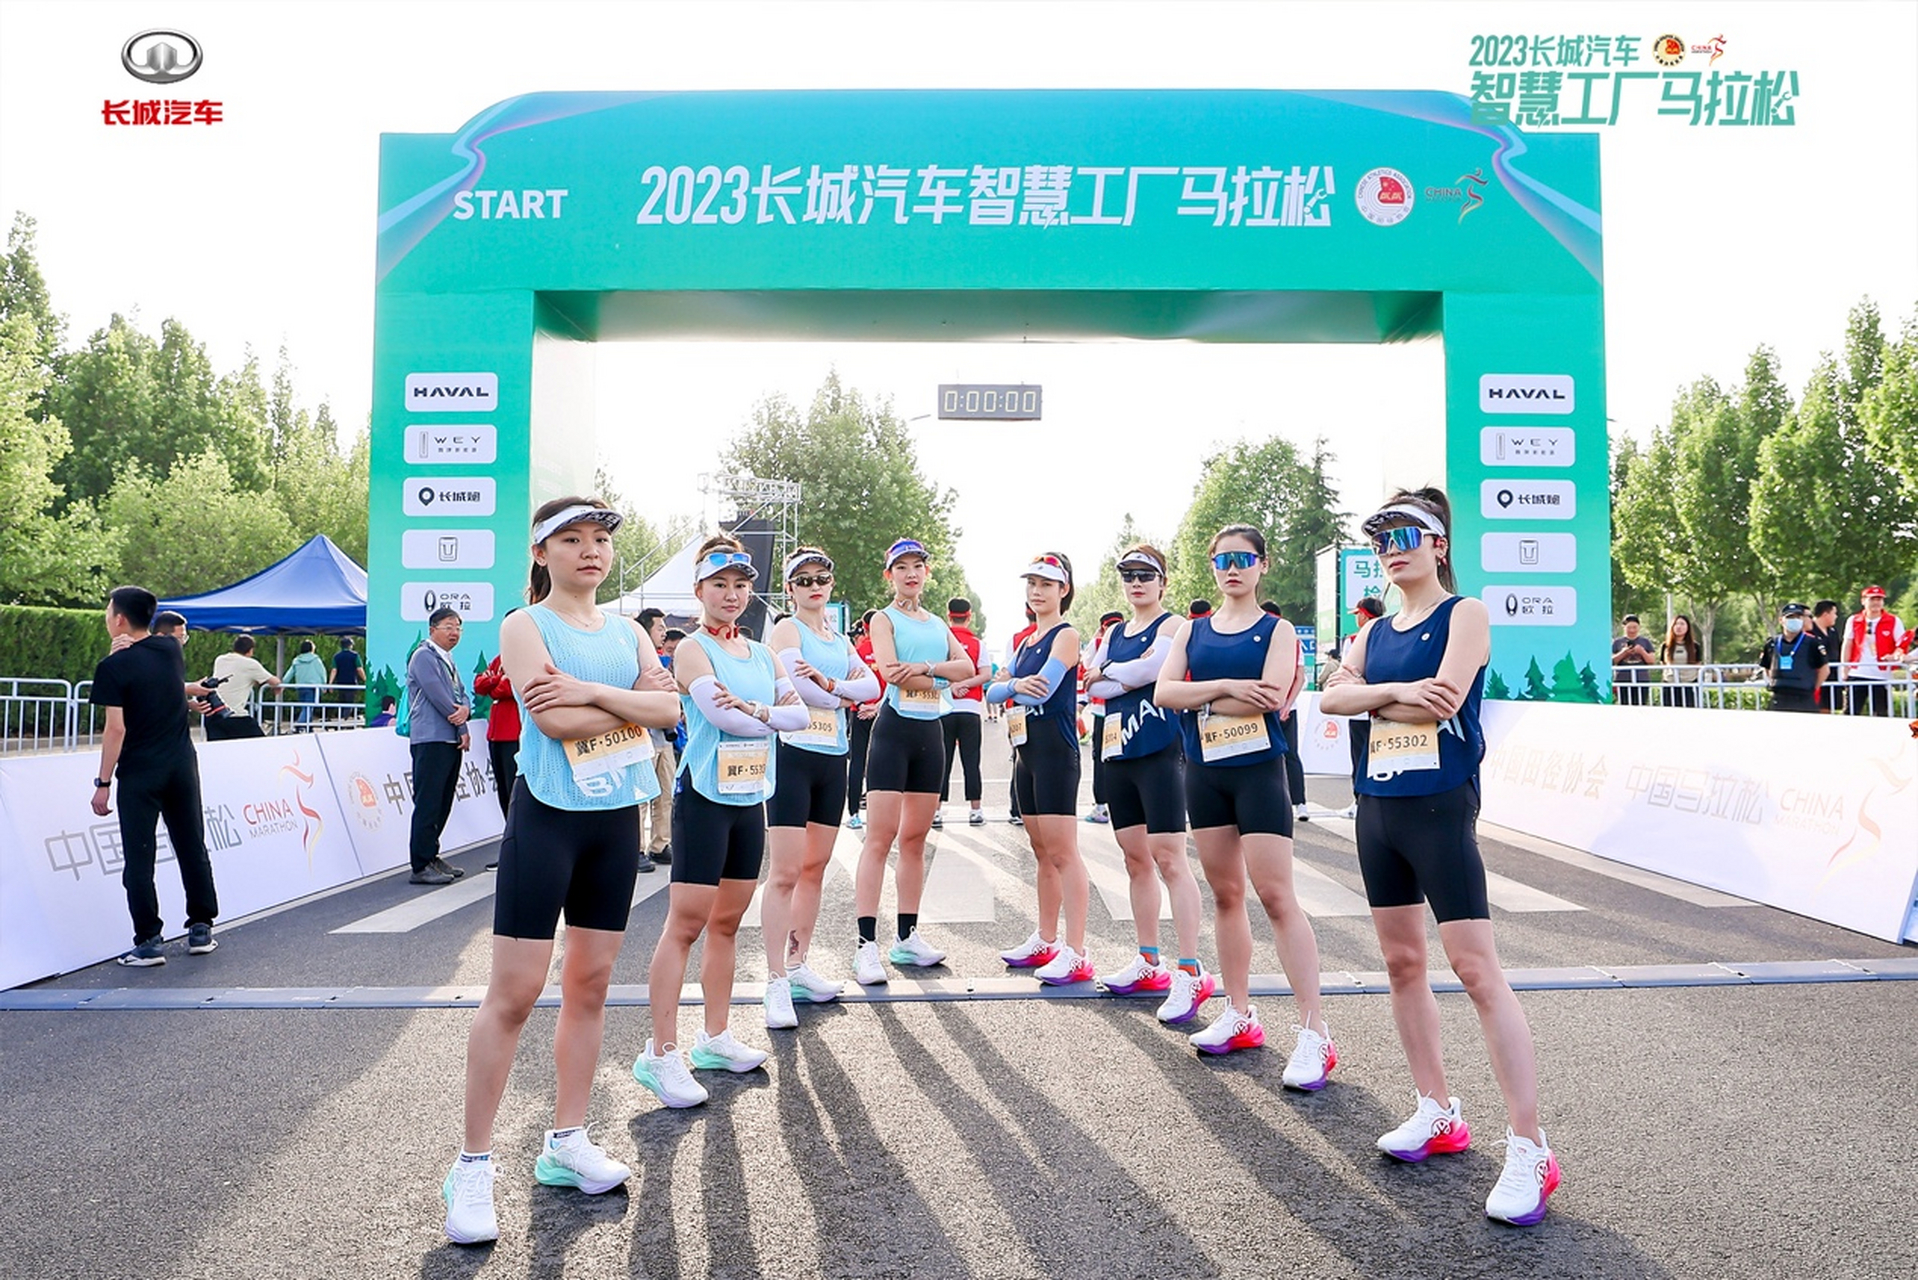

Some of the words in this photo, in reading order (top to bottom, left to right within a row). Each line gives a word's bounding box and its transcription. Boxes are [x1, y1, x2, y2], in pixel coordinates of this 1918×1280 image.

[637, 165, 1336, 228] 2023长城汽车智慧工厂马拉松
[1425, 187, 1462, 198] CHINA
[454, 189, 569, 220] START
[413, 387, 489, 398] HAVAL
[944, 391, 1036, 412] 0:00:00
[1489, 388, 1566, 400] HAVAL
[434, 436, 481, 444] WEY
[1511, 438, 1559, 447] WEY
[1625, 763, 1770, 825] 中国马拉松
[1779, 788, 1846, 821] CHINA
[242, 798, 295, 826] CHINA
[248, 818, 299, 839] MARATHON
